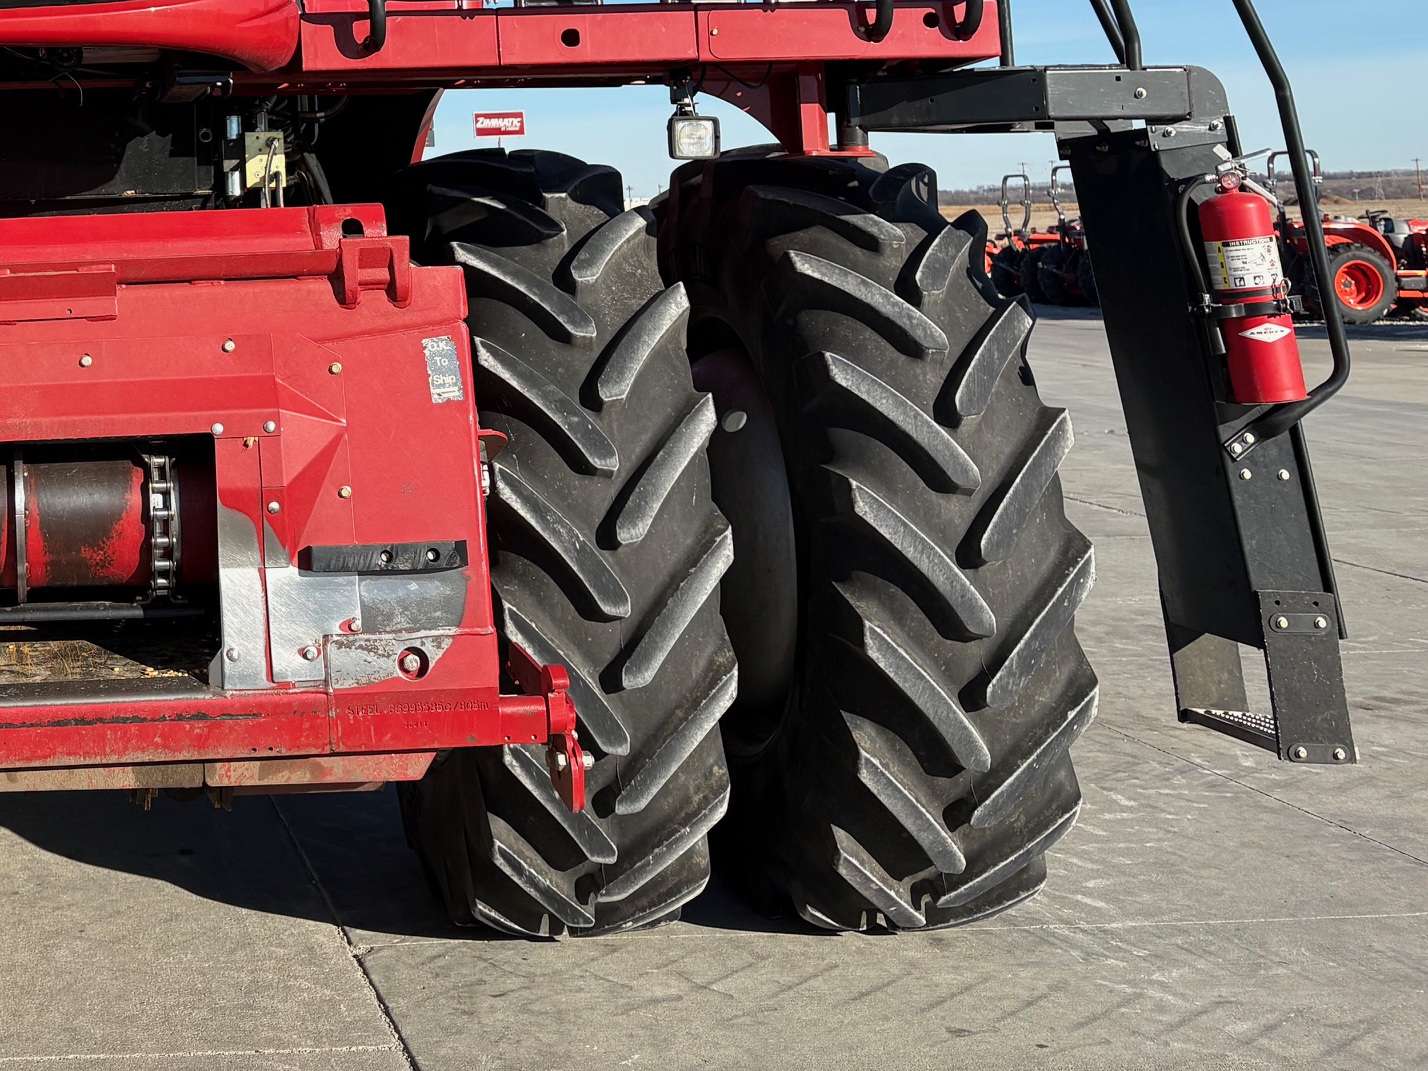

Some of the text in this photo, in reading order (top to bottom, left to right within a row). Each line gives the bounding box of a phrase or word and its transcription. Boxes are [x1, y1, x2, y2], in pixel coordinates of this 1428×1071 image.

[476, 117, 522, 128] ZIMMATIC
[433, 356, 449, 367] To
[432, 374, 457, 386] Ship
